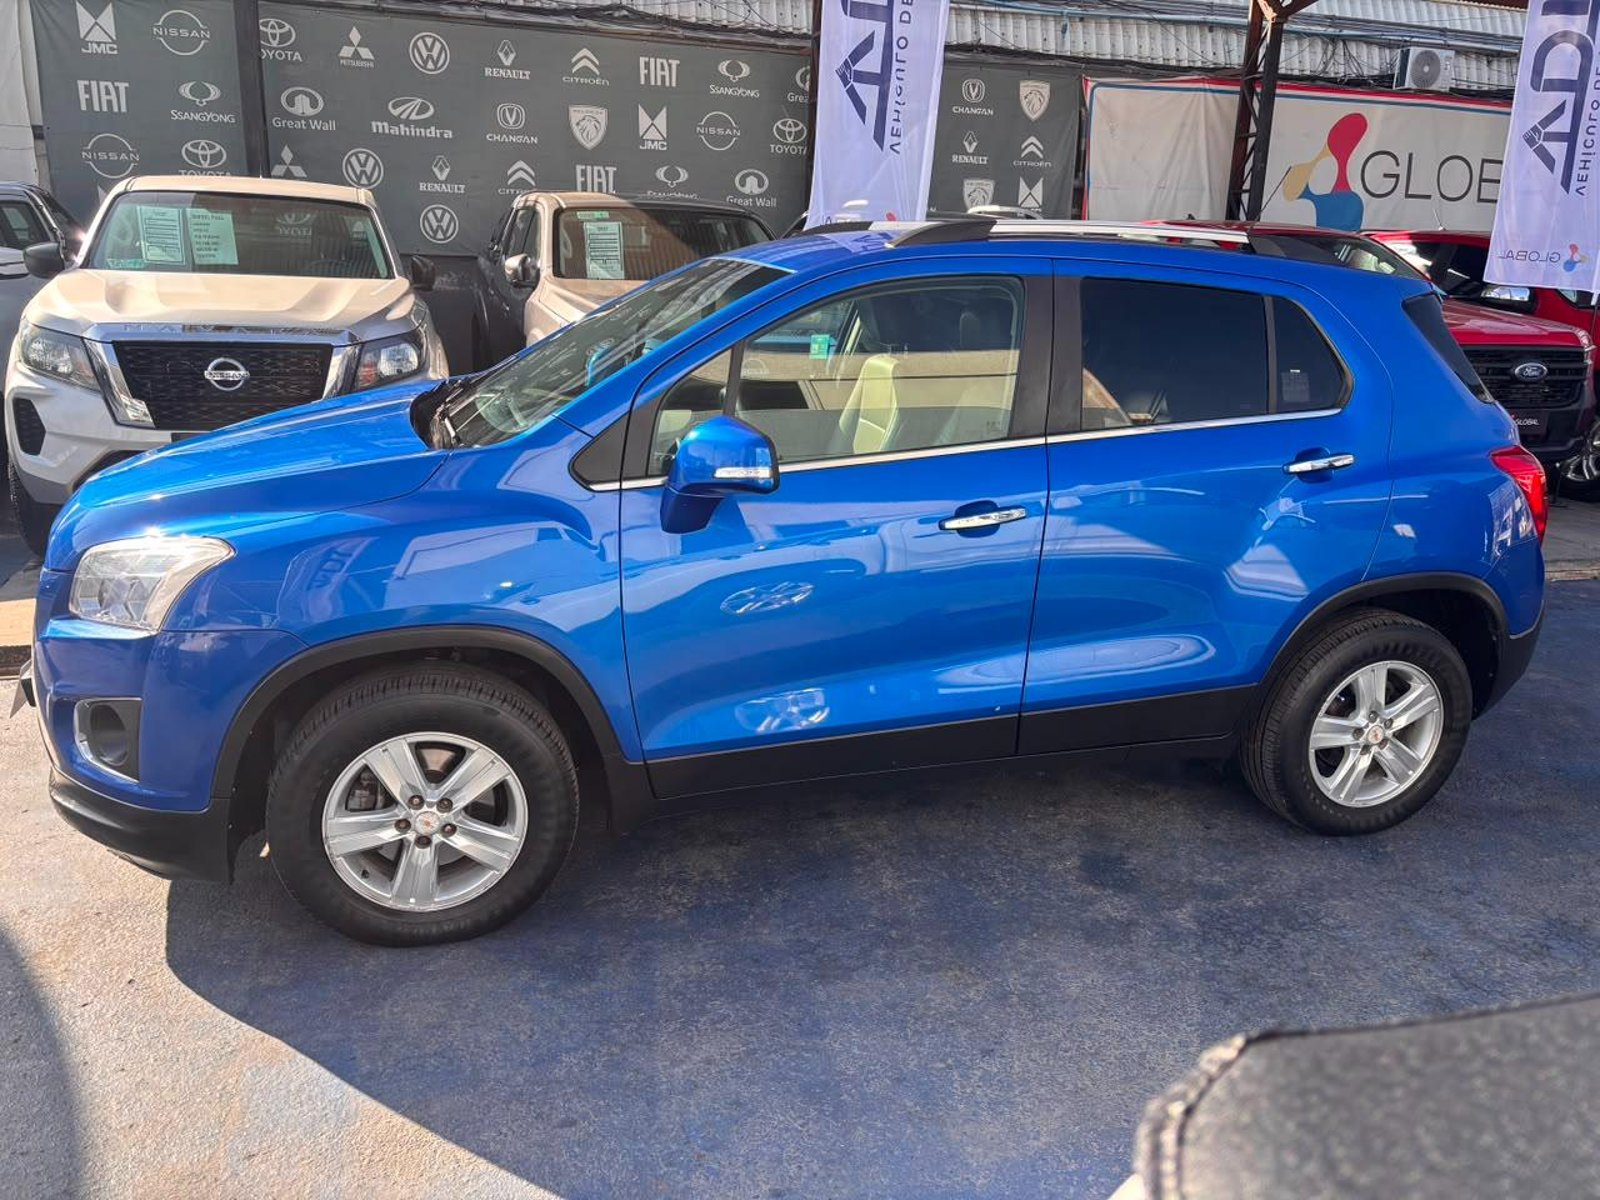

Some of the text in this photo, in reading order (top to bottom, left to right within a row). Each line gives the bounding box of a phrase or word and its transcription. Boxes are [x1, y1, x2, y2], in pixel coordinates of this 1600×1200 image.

[152, 27, 211, 38] NISSAN
[81, 42, 118, 55] JMC
[484, 67, 531, 80] RENAULT
[639, 56, 680, 87] FIAT
[77, 80, 129, 113] FIAT
[952, 106, 994, 116] CHANGAN
[272, 117, 336, 131] Great Wall
[696, 126, 741, 136] NISSAN
[486, 133, 538, 144] CHANGAN
[639, 140, 668, 151] JMC
[82, 151, 140, 161] NISSAN
[952, 154, 989, 165] RENAULT
[575, 164, 617, 194] FIAT
[419, 182, 465, 194] RENAULT
[726, 195, 777, 208] Great Wall
